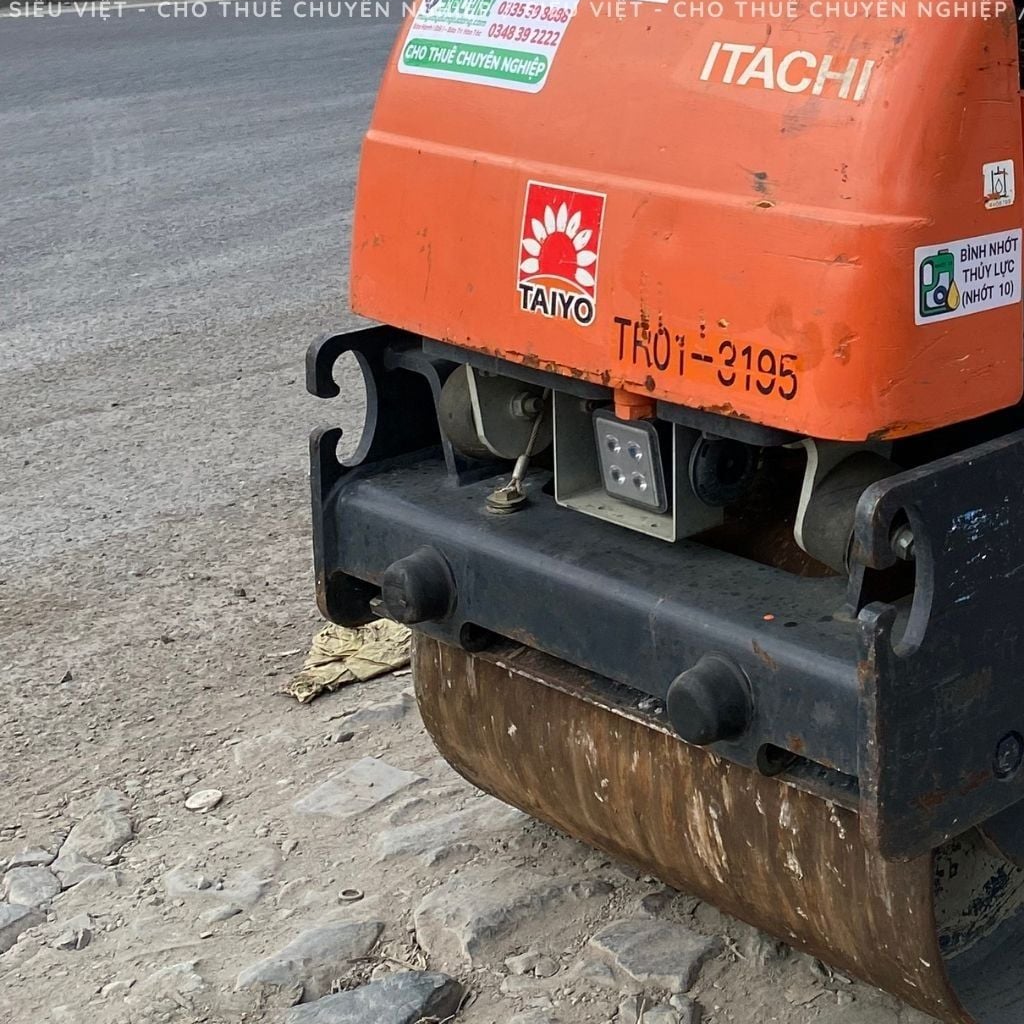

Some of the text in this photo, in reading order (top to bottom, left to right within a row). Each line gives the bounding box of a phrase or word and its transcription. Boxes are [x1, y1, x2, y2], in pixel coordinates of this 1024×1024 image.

[487, 23, 517, 40] 0348
[515, 26, 532, 42] 39
[530, 28, 561, 47] 2222
[405, 44, 546, 80] CHO THUÊ CHUYÊN NGHIỆP
[699, 41, 876, 102] ITACHI
[960, 236, 1019, 263] BÌNH NHỚT
[962, 261, 993, 284] THỦY
[994, 258, 1015, 278] LỰC
[518, 283, 594, 324] TAIYO
[962, 279, 1014, 309] (NHỚT 10)
